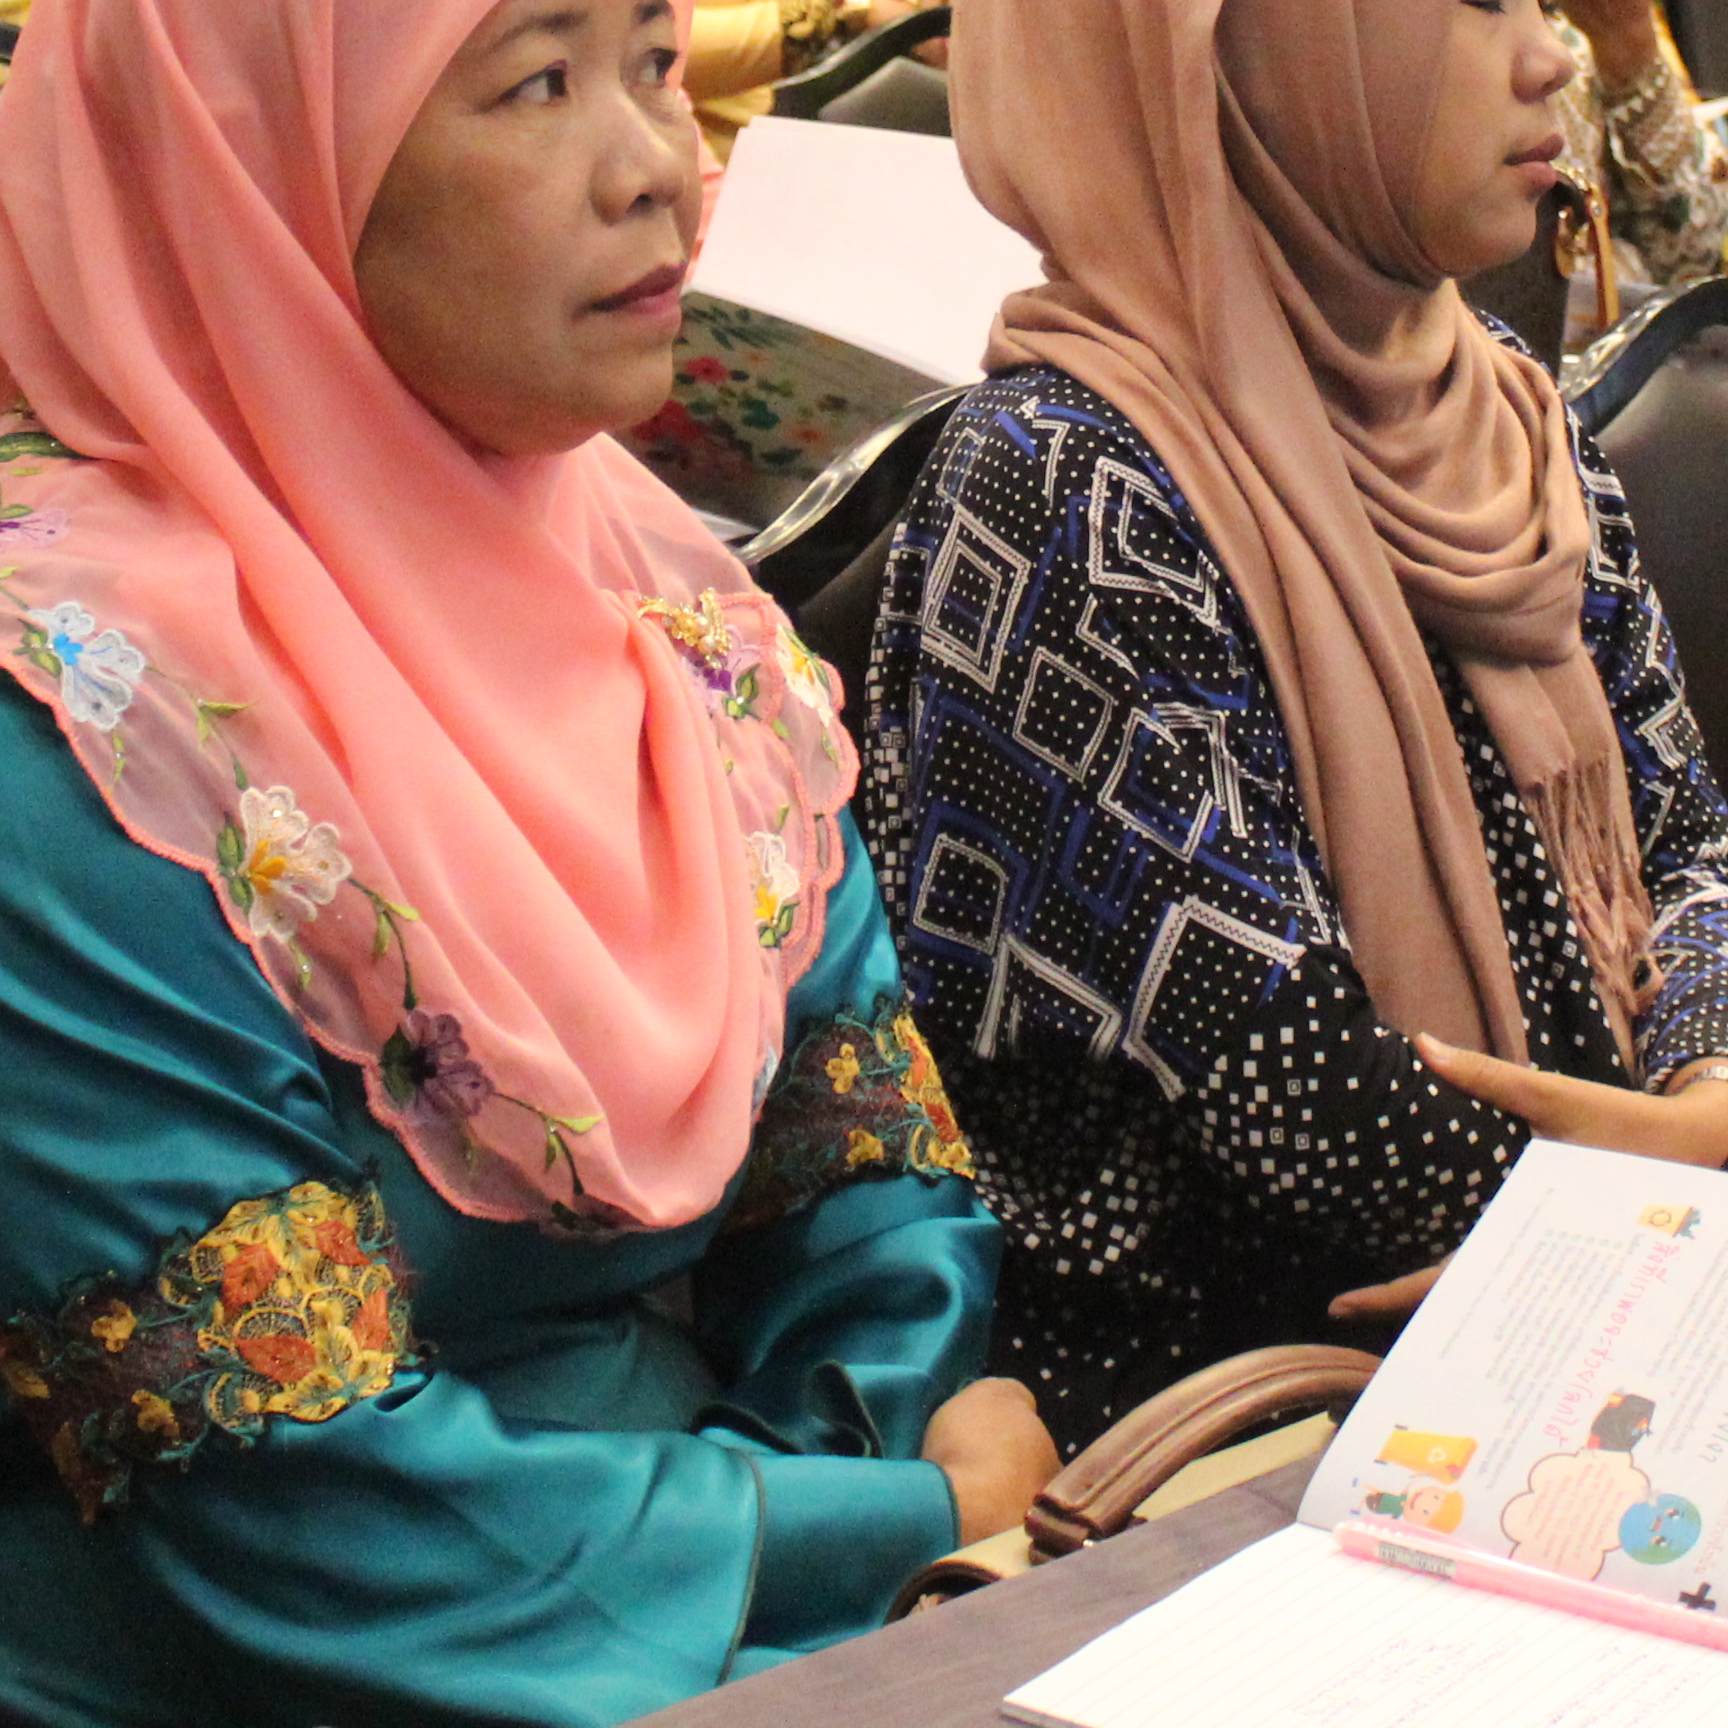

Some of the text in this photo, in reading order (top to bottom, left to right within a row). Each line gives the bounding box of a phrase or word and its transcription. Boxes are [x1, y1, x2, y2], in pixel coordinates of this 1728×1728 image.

[1545, 1243, 1680, 1444] สิ่งที่เราพอจะช่วยโลกได้
